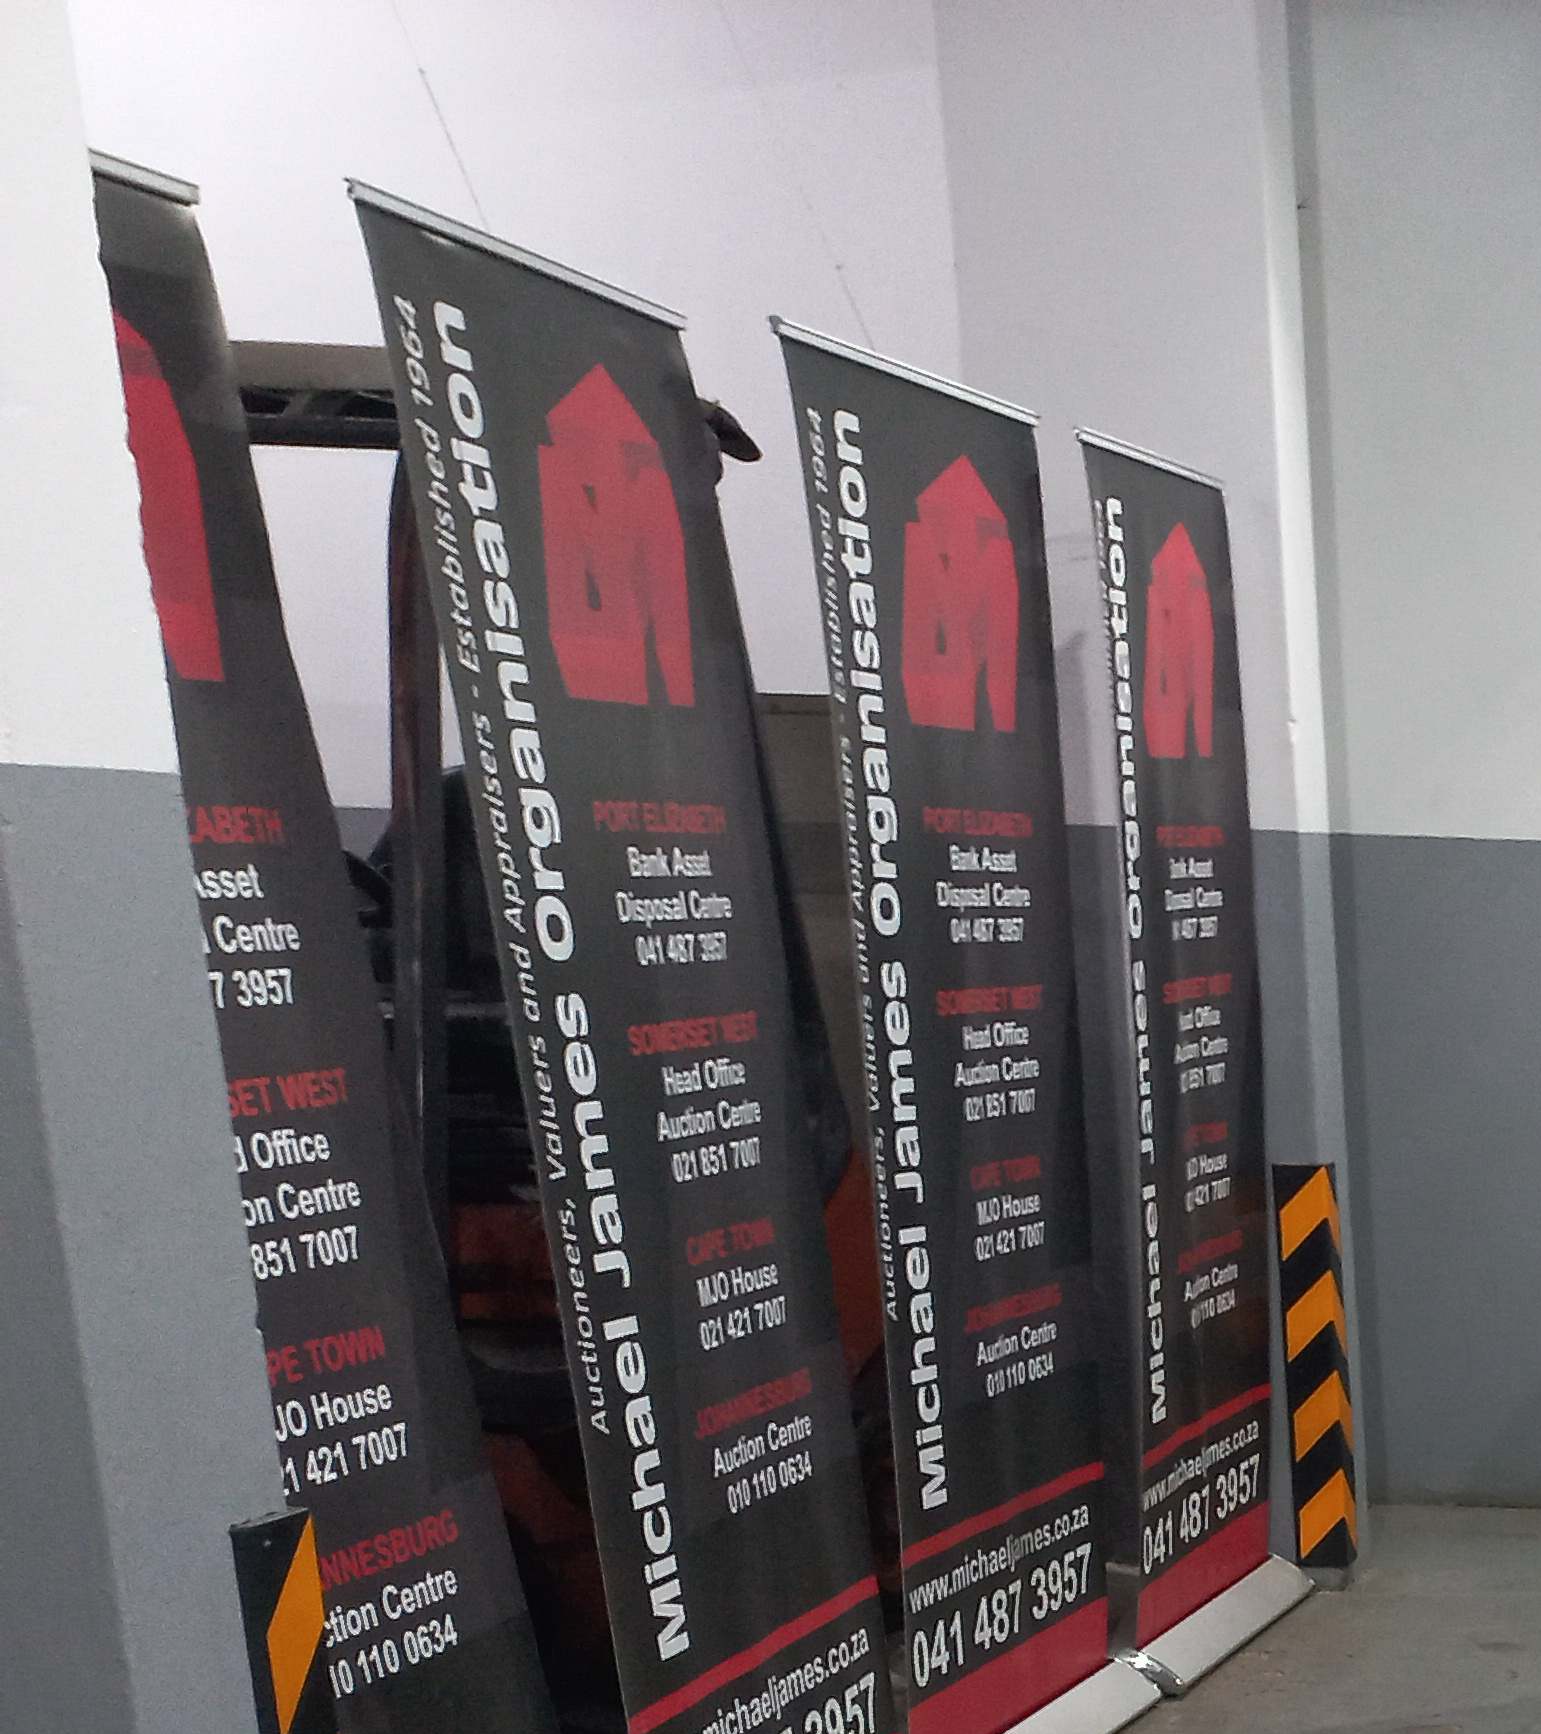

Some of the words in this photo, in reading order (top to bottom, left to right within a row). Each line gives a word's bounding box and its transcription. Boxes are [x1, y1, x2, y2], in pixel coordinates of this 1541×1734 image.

[393, 294, 433, 407] 1964
[414, 417, 481, 674] Established
[433, 300, 575, 962] Organisation
[833, 408, 901, 937] Organisation
[472, 711, 527, 934] Appraisers
[626, 845, 672, 877] Bank
[672, 846, 714, 877] Asset
[212, 914, 301, 954] Centre
[615, 890, 688, 929] Disposal
[688, 889, 733, 920] Centre
[232, 967, 294, 1008] 3957
[508, 941, 542, 1023] and
[276, 1066, 347, 1110] WEST
[528, 1033, 568, 1183] Valuers
[660, 1062, 703, 1097] Head
[703, 1057, 747, 1090] Office
[880, 960, 925, 1204] James
[250, 1128, 331, 1170] Office
[555, 992, 632, 1289] James
[657, 1105, 717, 1143] Auction
[717, 1099, 762, 1130] Centre
[671, 1150, 699, 1184] 021
[699, 1143, 729, 1177] 851
[729, 1136, 761, 1170] 7007
[277, 1178, 362, 1221] Centre
[1001, 1194, 1041, 1220] House
[250, 1237, 297, 1281] 851
[300, 1224, 360, 1270] 7007
[731, 1263, 779, 1297] House
[557, 1197, 611, 1436] Auctioneers,
[699, 1315, 725, 1351] 021
[726, 1306, 753, 1340] 421
[753, 1295, 788, 1331] 7007
[1142, 1183, 1167, 1424] Michael
[304, 1323, 386, 1375] TOWN
[898, 1225, 949, 1511] Michael
[311, 1382, 394, 1431] House
[305, 1440, 350, 1487] 421
[352, 1422, 408, 1472] 7007
[713, 1433, 766, 1478] Auction
[767, 1415, 813, 1452] Centre
[603, 1314, 690, 1662] Michael
[726, 1478, 751, 1514] 010
[751, 1464, 777, 1500] 110
[778, 1450, 813, 1489] 0634
[1142, 1509, 1174, 1576] 041
[1179, 1484, 1211, 1543] 487
[1215, 1453, 1261, 1520] 3957
[908, 1504, 1090, 1614] www.michaeljames.co.za
[382, 1567, 458, 1620] Centre
[913, 1610, 964, 1688] 041
[974, 1578, 1022, 1650] 487
[1030, 1542, 1092, 1620] 3957
[357, 1637, 400, 1684] 110
[403, 1613, 458, 1665] 0634
